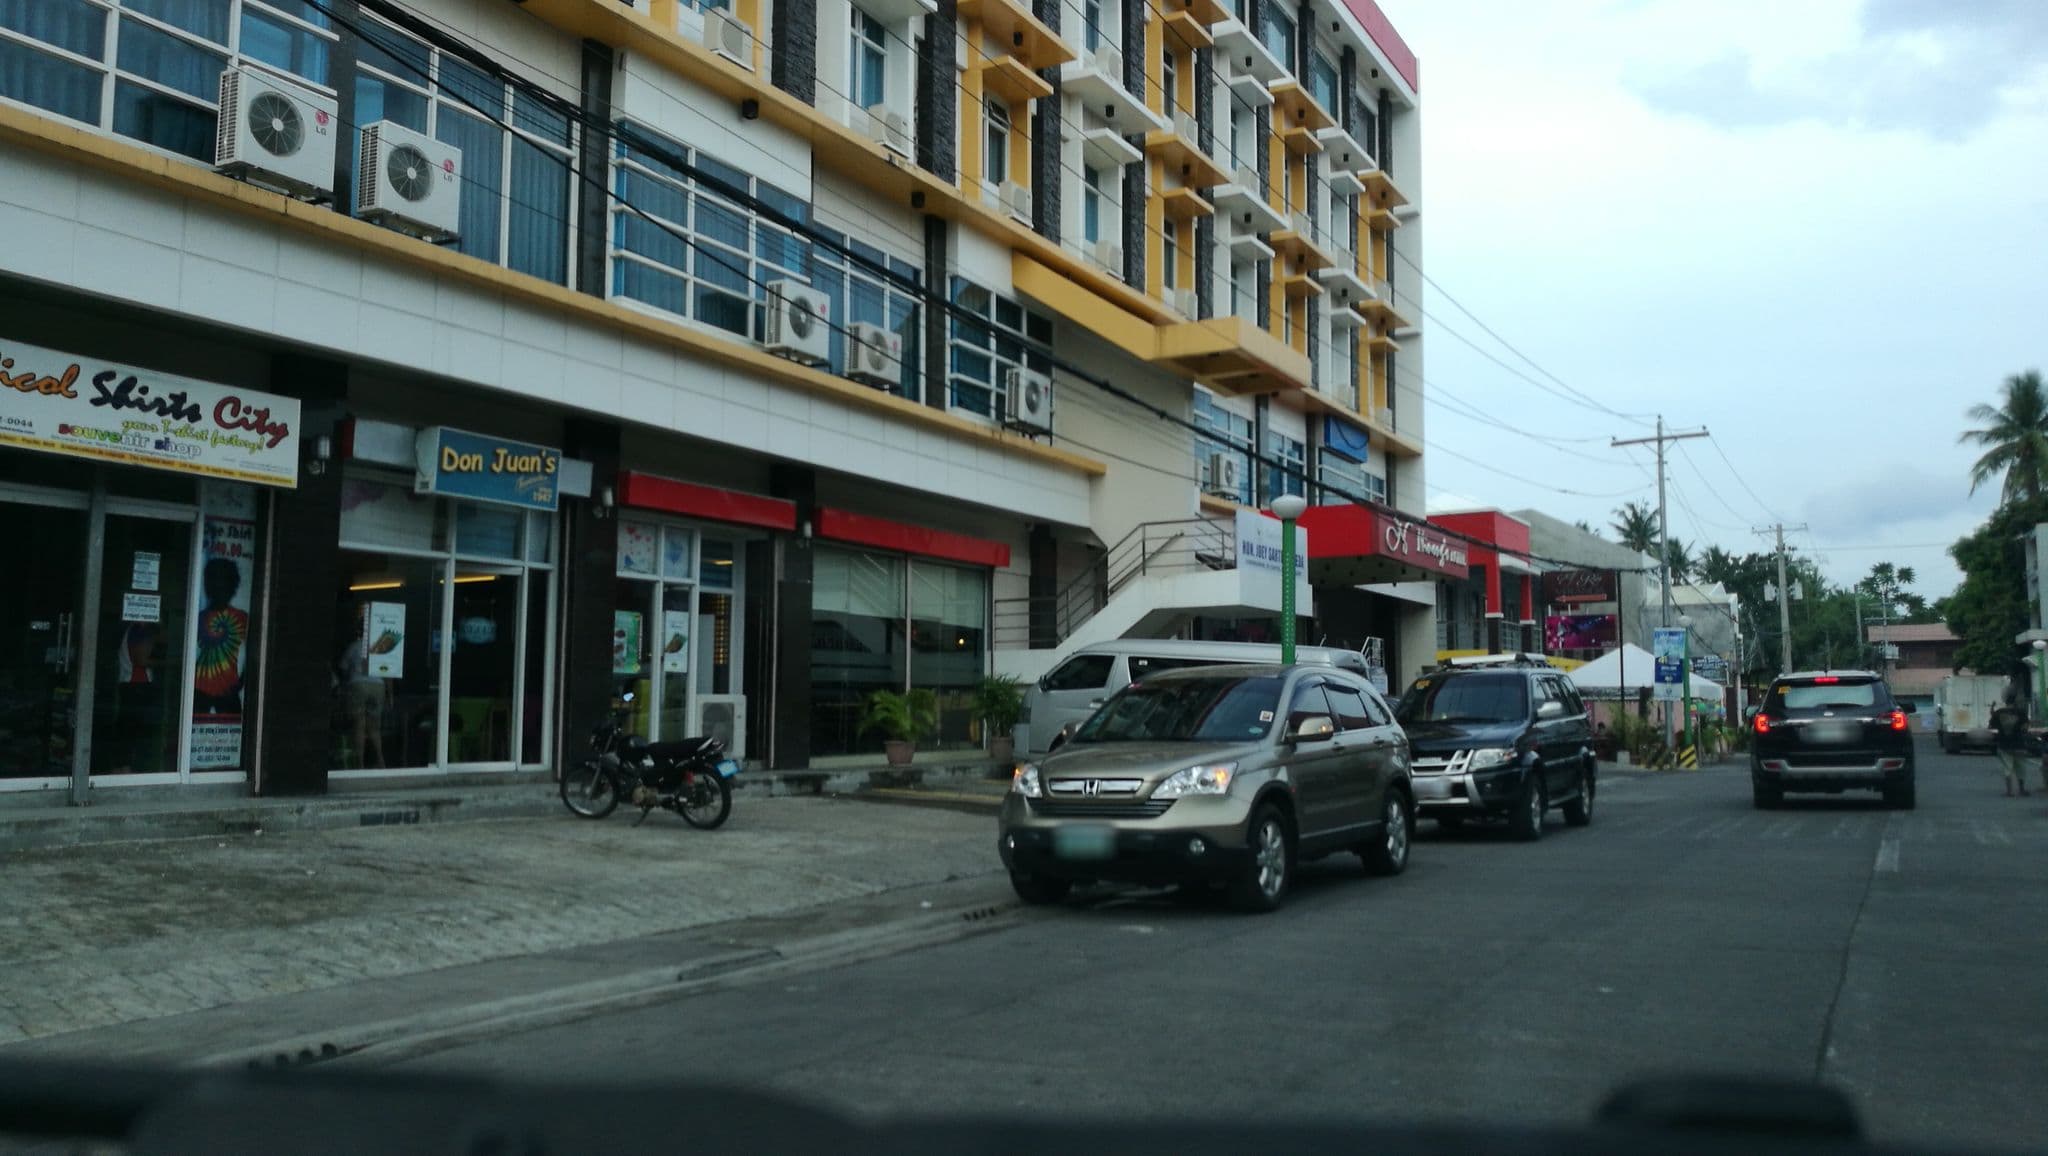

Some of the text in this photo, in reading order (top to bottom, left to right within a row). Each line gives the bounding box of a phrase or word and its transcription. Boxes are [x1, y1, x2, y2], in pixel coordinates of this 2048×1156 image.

[315, 124, 327, 136] LG
[0, 355, 80, 399] icol
[90, 370, 202, 423] Shirts
[213, 396, 289, 448] City
[59, 423, 150, 449] souvenir
[154, 437, 201, 457] shop
[442, 446, 556, 474] Don Juan's
